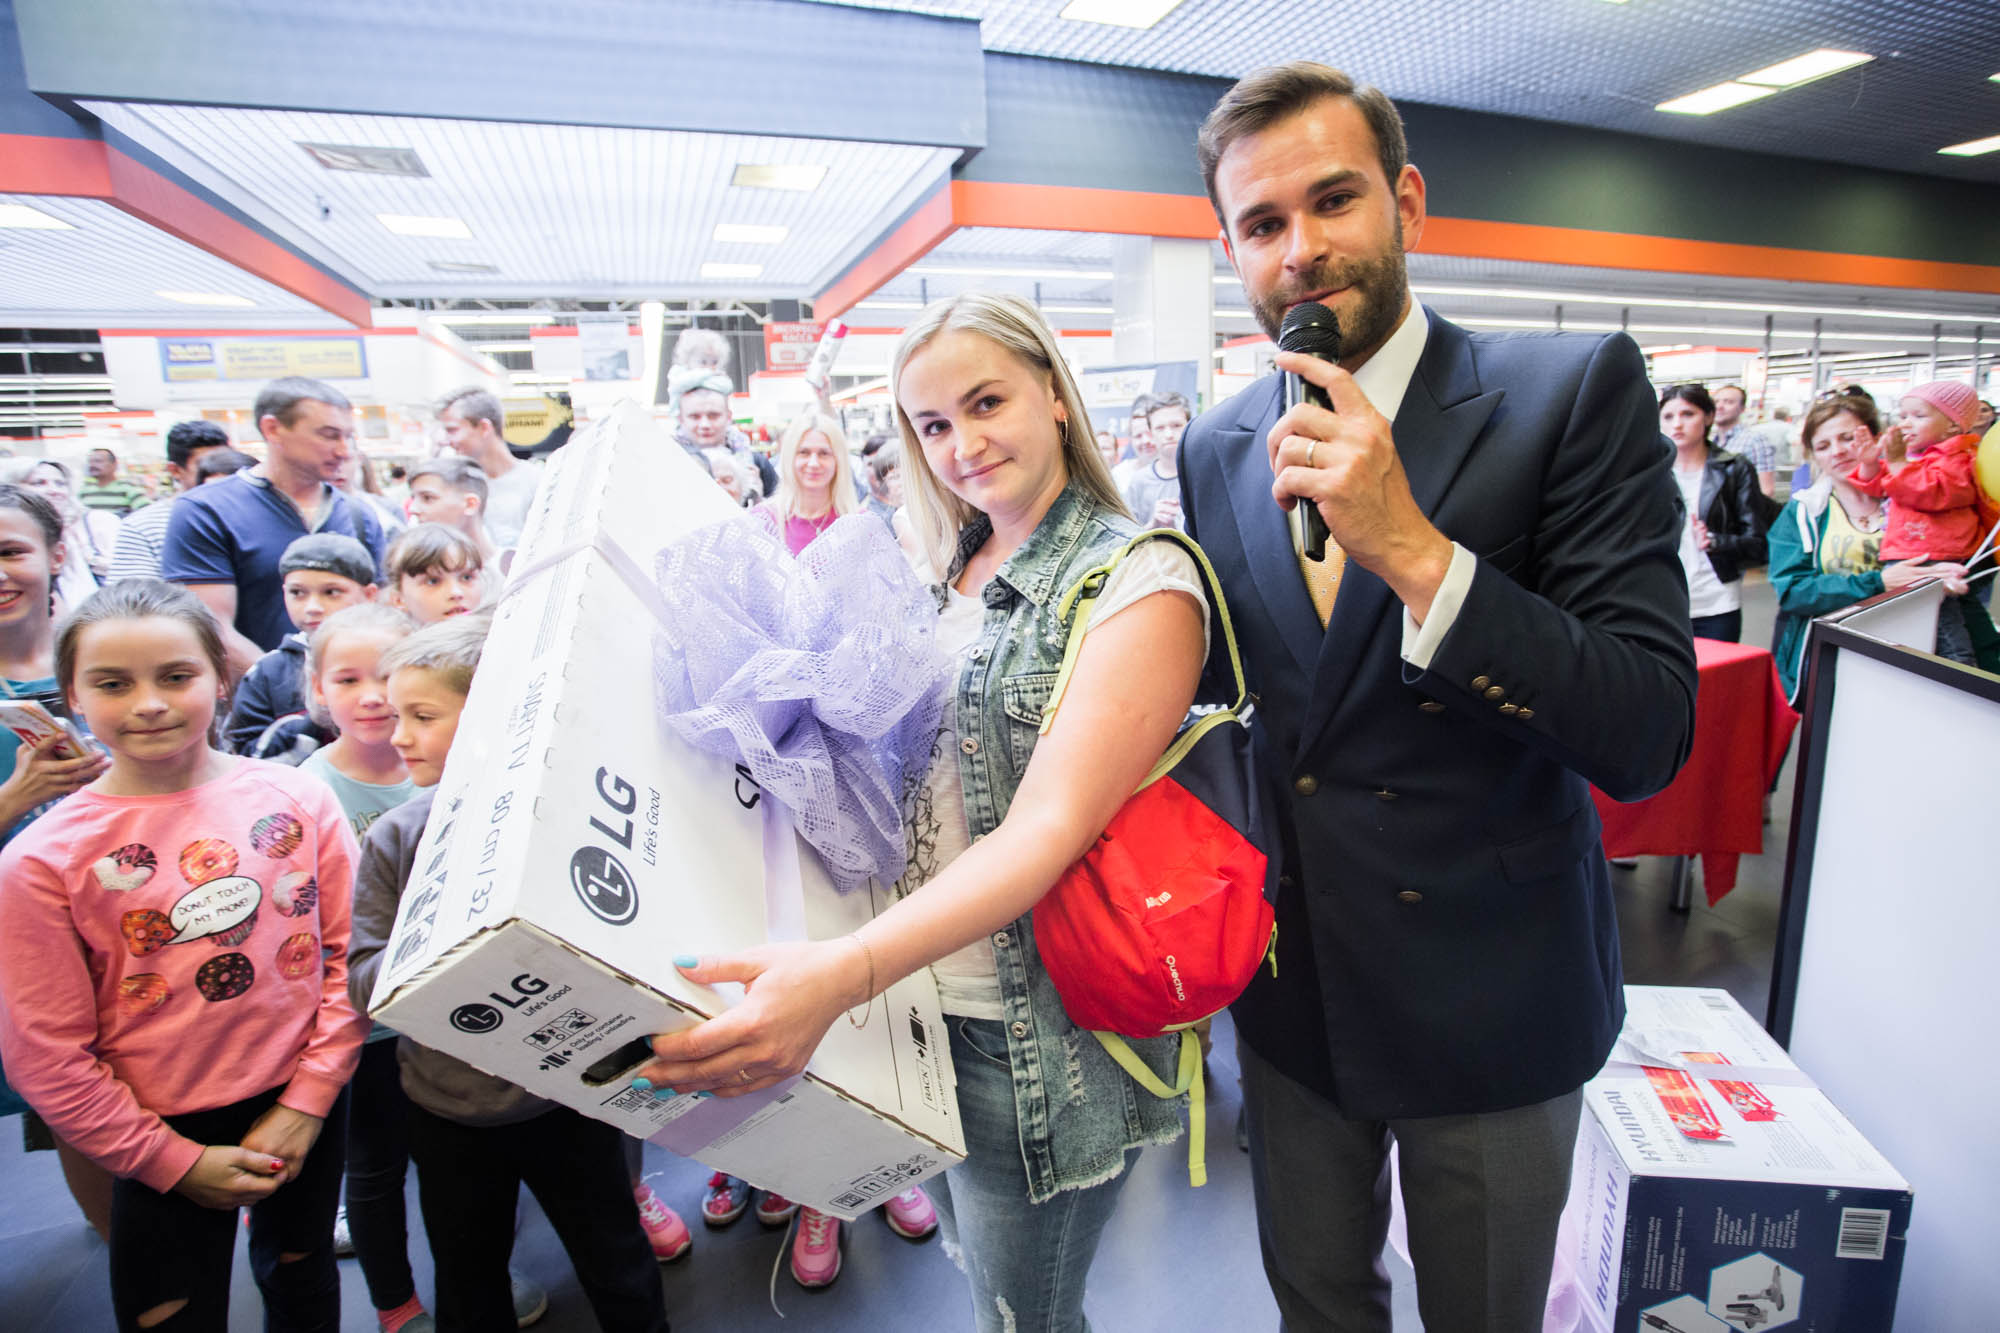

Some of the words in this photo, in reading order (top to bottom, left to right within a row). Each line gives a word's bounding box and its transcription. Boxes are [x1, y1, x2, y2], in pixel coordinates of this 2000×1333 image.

[516, 672, 547, 737] SMART
[508, 736, 532, 770] TV
[491, 790, 513, 825] 80
[590, 766, 637, 851] LG
[647, 786, 661, 826] Good
[479, 828, 501, 865] cm
[643, 828, 658, 867] Life's
[195, 913, 212, 925] MY
[466, 880, 493, 923] 32
[489, 974, 550, 1009] LG
[521, 1000, 549, 1017] Life's
[545, 985, 573, 1003] Good
[570, 1038, 586, 1048] Only
[595, 1013, 623, 1032] container
[576, 1036, 602, 1051] loading
[604, 1015, 636, 1035] unloading
[1603, 1091, 1662, 1161] HYUNDAI
[1595, 1171, 1618, 1312] HYUNDAI
